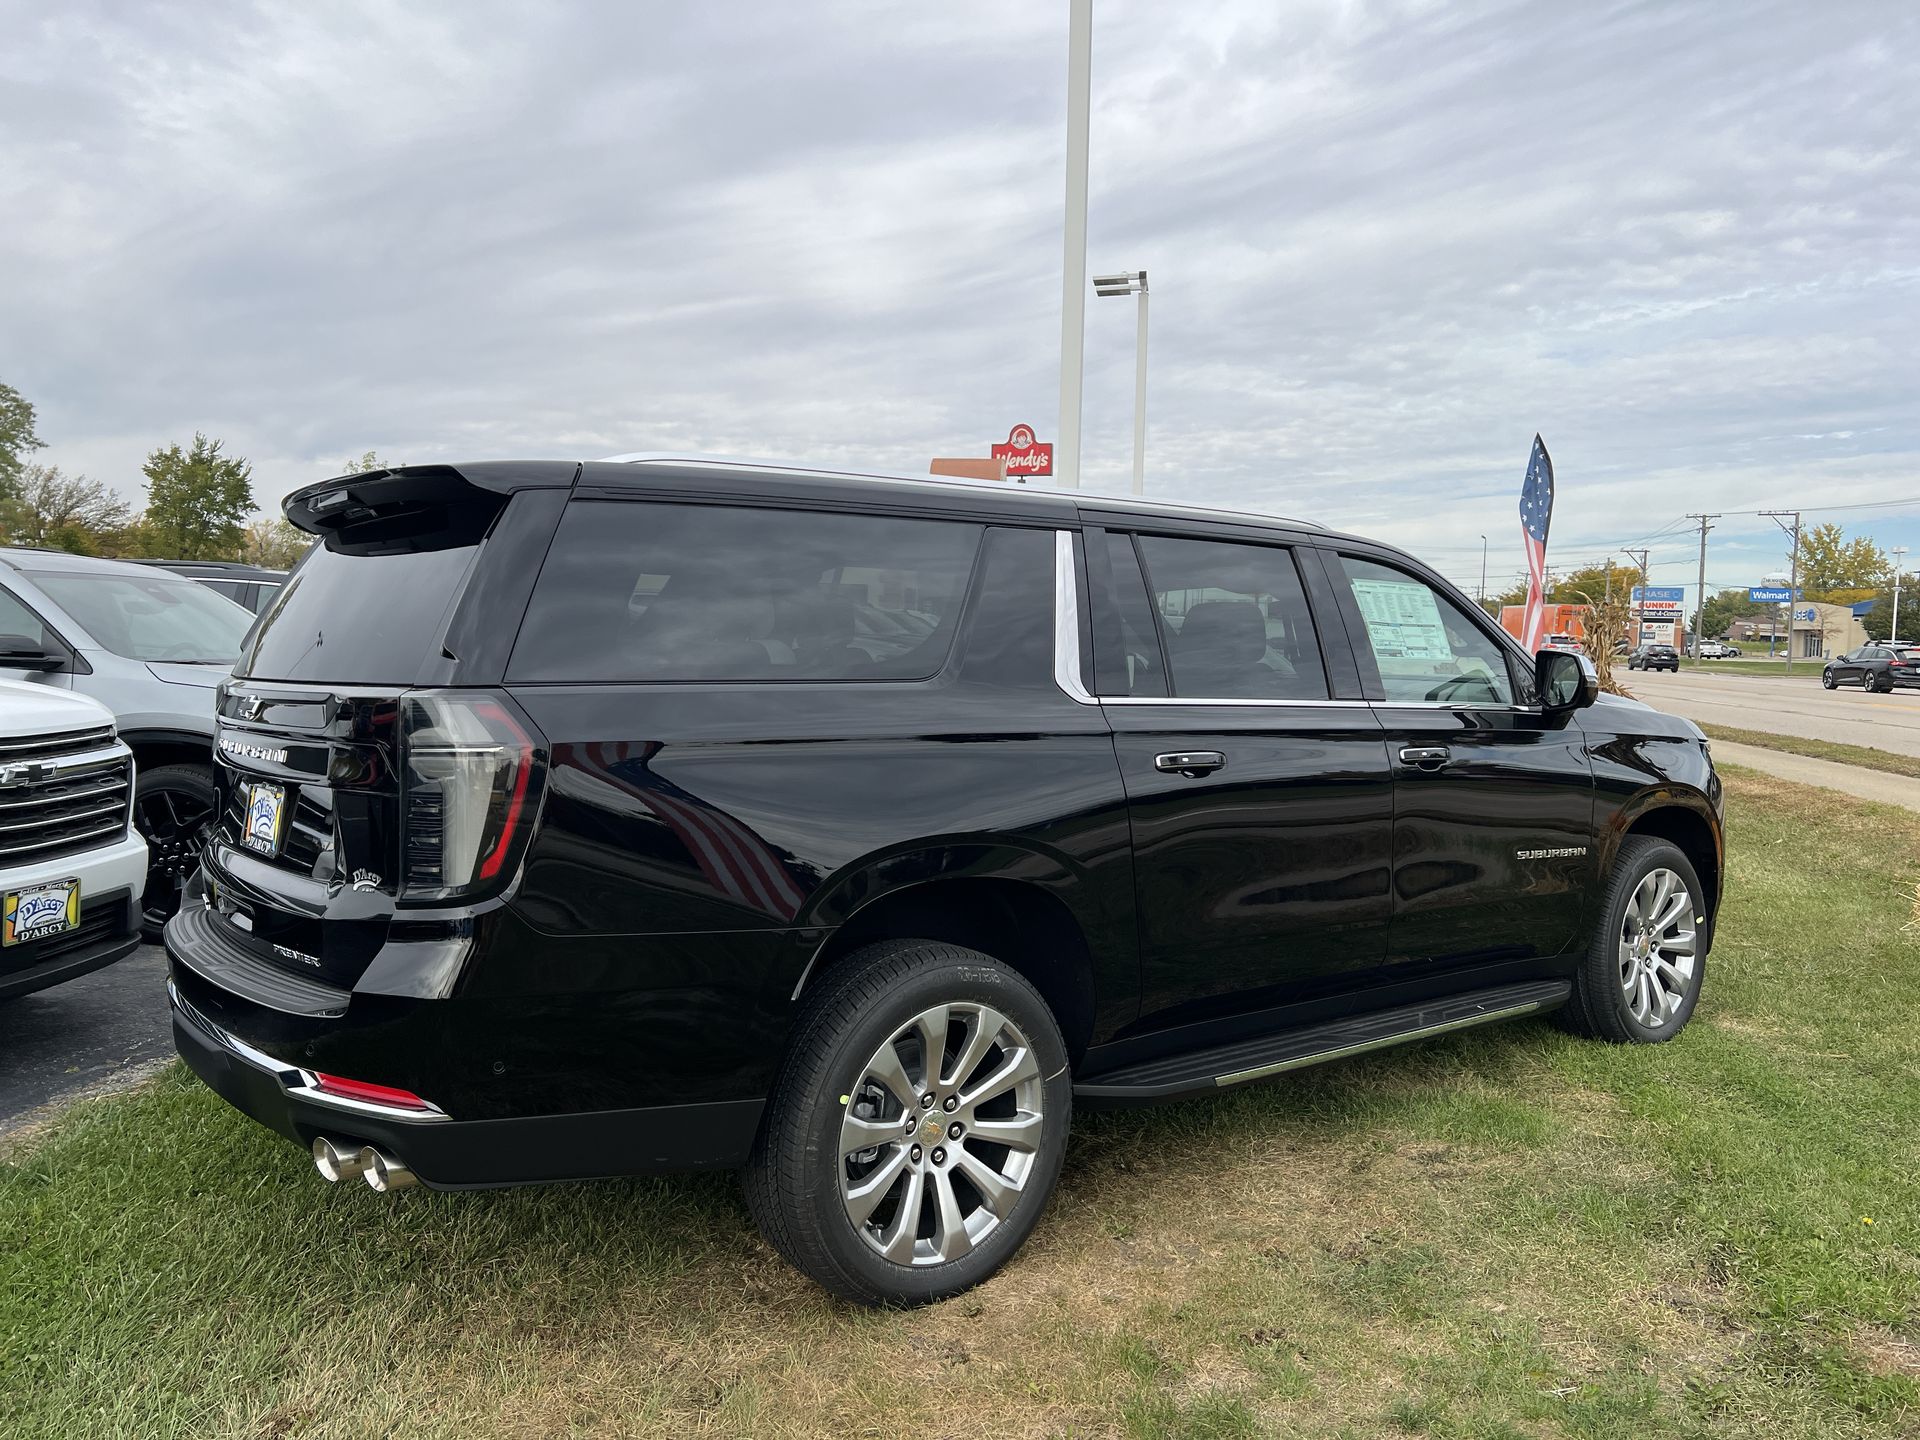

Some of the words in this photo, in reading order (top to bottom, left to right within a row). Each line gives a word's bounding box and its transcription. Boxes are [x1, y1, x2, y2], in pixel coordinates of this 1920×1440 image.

[1752, 591, 1790, 600] Walmart
[1517, 847, 1586, 859] SUBURBAN
[353, 868, 382, 887] D'Arcy
[20, 897, 64, 922] D'Arcy
[21, 922, 64, 940] D'ARCY
[273, 944, 321, 967] PREMIER
